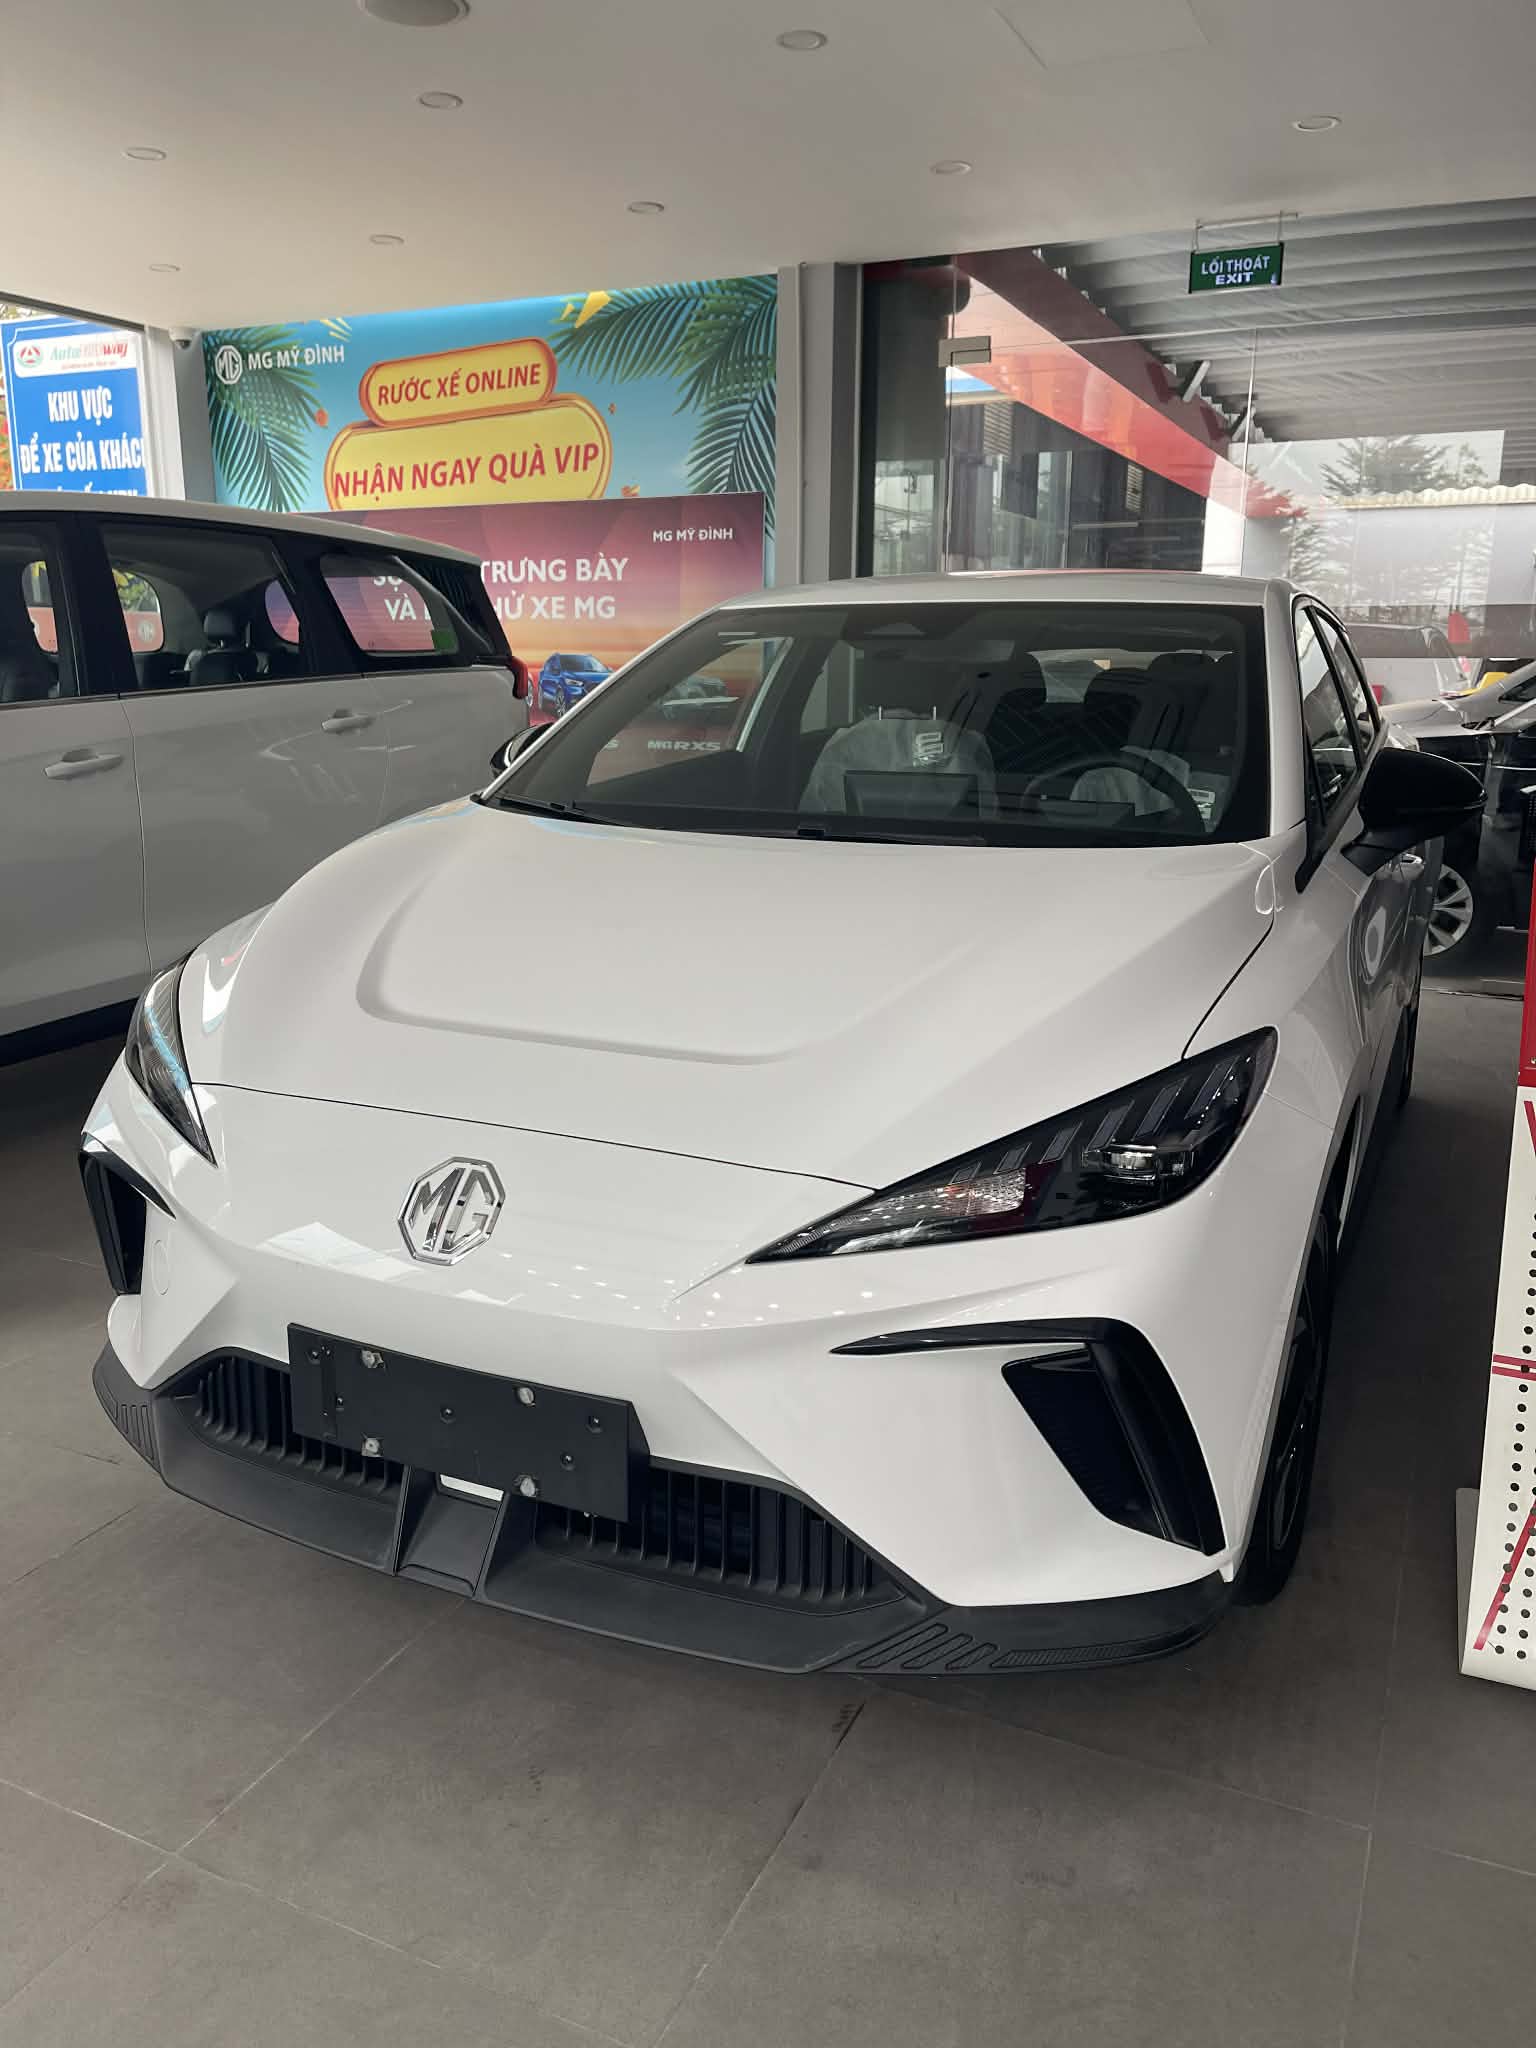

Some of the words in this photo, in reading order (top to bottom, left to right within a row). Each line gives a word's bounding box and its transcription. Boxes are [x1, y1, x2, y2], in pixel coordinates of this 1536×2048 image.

[1216, 272, 1253, 285] EXIT
[248, 351, 273, 370] MG
[276, 345, 300, 368] MỸ
[304, 343, 345, 365] ĐÌNH
[378, 376, 432, 406] RƯỚC
[436, 368, 463, 398] XẾ
[465, 363, 542, 394] ONLINE
[47, 391, 79, 422] KHU
[81, 385, 113, 426] VỰC
[42, 442, 63, 473] XE
[65, 431, 97, 472] CỦA
[333, 462, 404, 502] NHẬN
[411, 456, 482, 491] NGAY
[488, 443, 546, 484] QUÀ
[554, 442, 599, 473] VIP
[653, 530, 673, 543] MG
[676, 527, 696, 542] MỸ
[698, 525, 733, 541] ĐÌNH
[575, 551, 629, 582] BÀY
[384, 592, 417, 622] VÀ
[529, 596, 566, 621] XE
[574, 595, 616, 621] MG
[402, 1160, 502, 1262] MG
